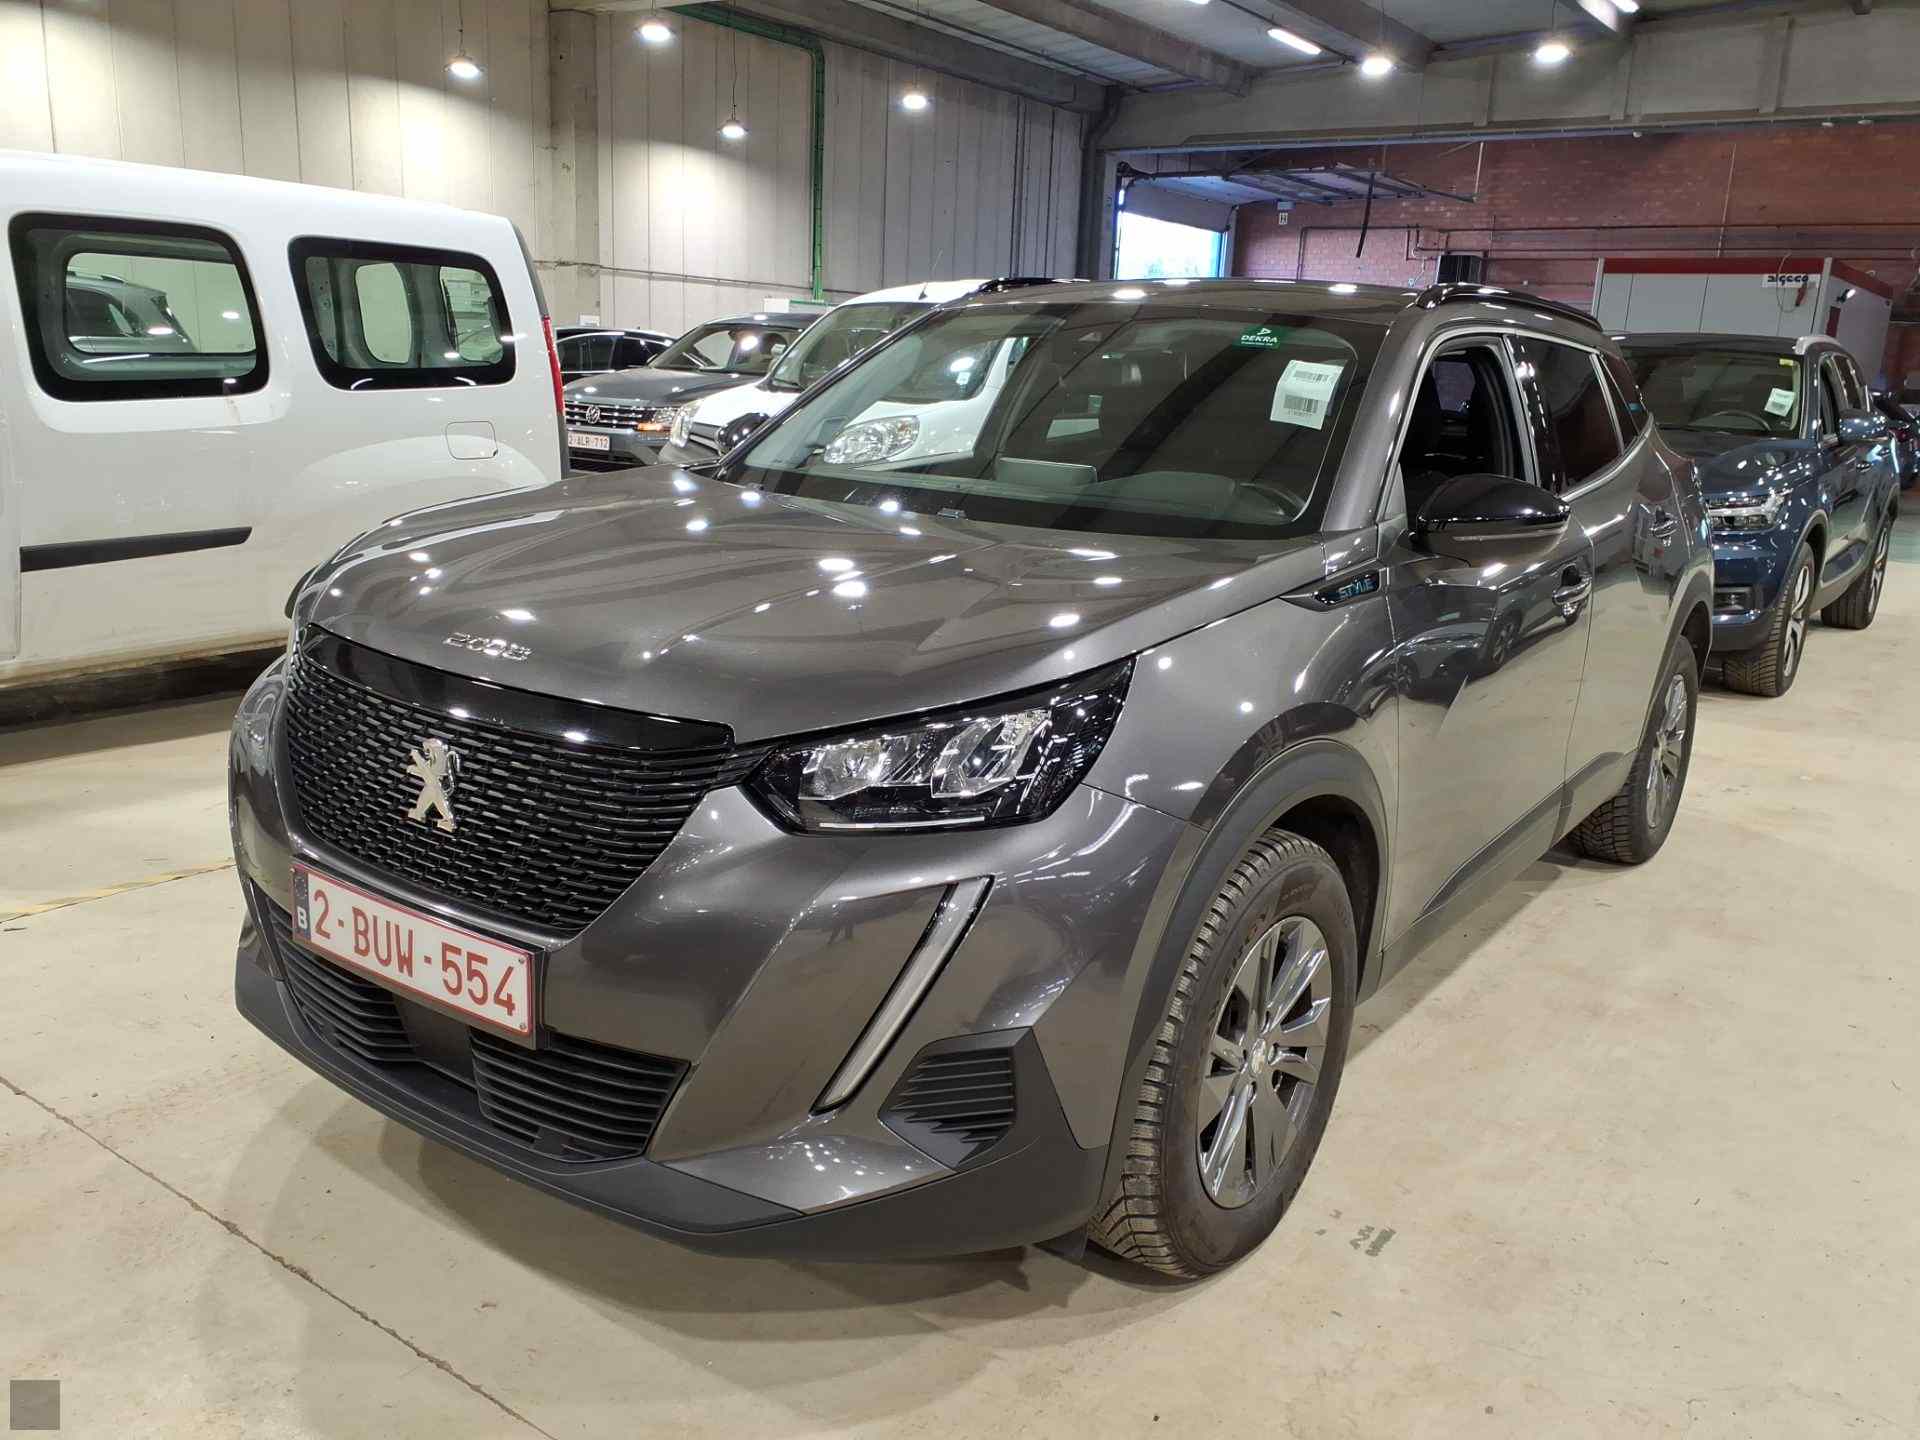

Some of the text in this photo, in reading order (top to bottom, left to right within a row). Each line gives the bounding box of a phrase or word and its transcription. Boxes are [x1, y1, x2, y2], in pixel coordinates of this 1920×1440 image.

[1767, 273, 1809, 286] algeco
[1241, 334, 1278, 343] DEKRA
[1340, 579, 1376, 599] STYLE
[442, 632, 532, 660] 2008
[296, 906, 308, 930] B
[313, 889, 516, 1017] 2-BUW-554
